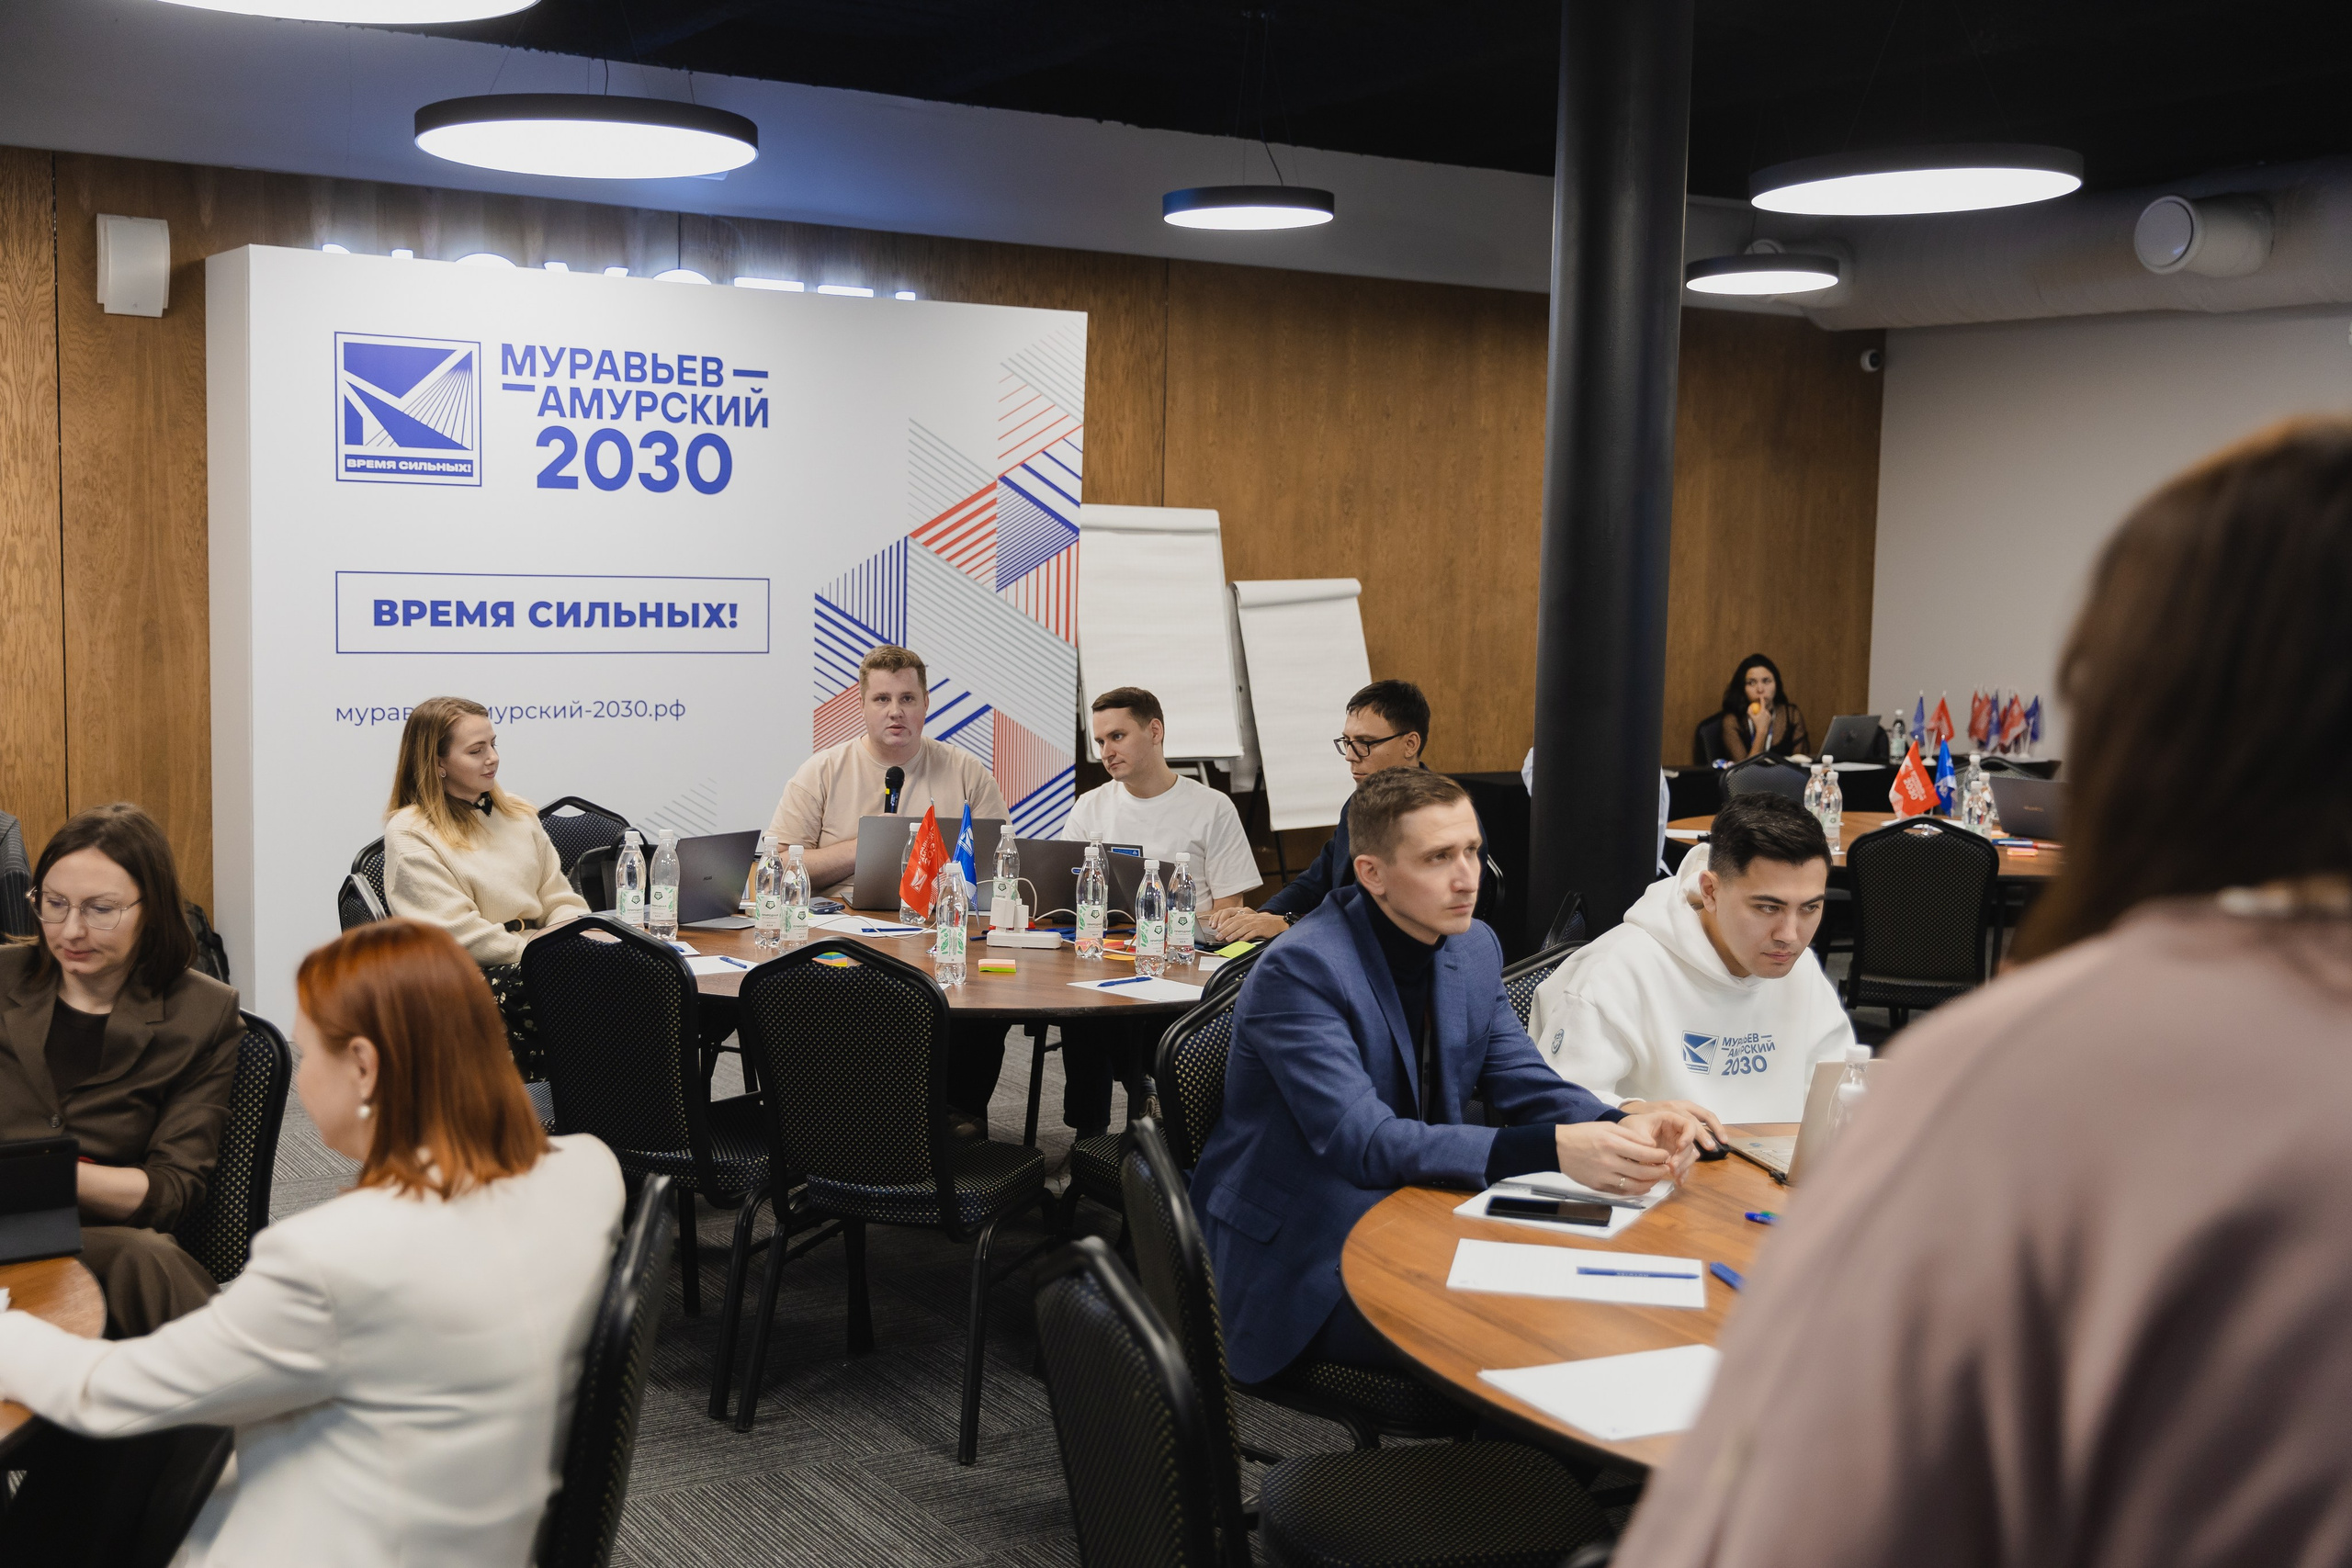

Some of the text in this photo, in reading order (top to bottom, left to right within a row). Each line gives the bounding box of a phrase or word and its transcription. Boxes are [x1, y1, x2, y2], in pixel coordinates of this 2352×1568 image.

[346, 458, 472, 473] ВРЕМЯ СИЛЬНЫХ!
[536, 425, 733, 495] 2030
[373, 599, 738, 628] ВРЕМЯ СИЛЬНЫХ!
[1721, 1055, 1768, 1076] 2030
